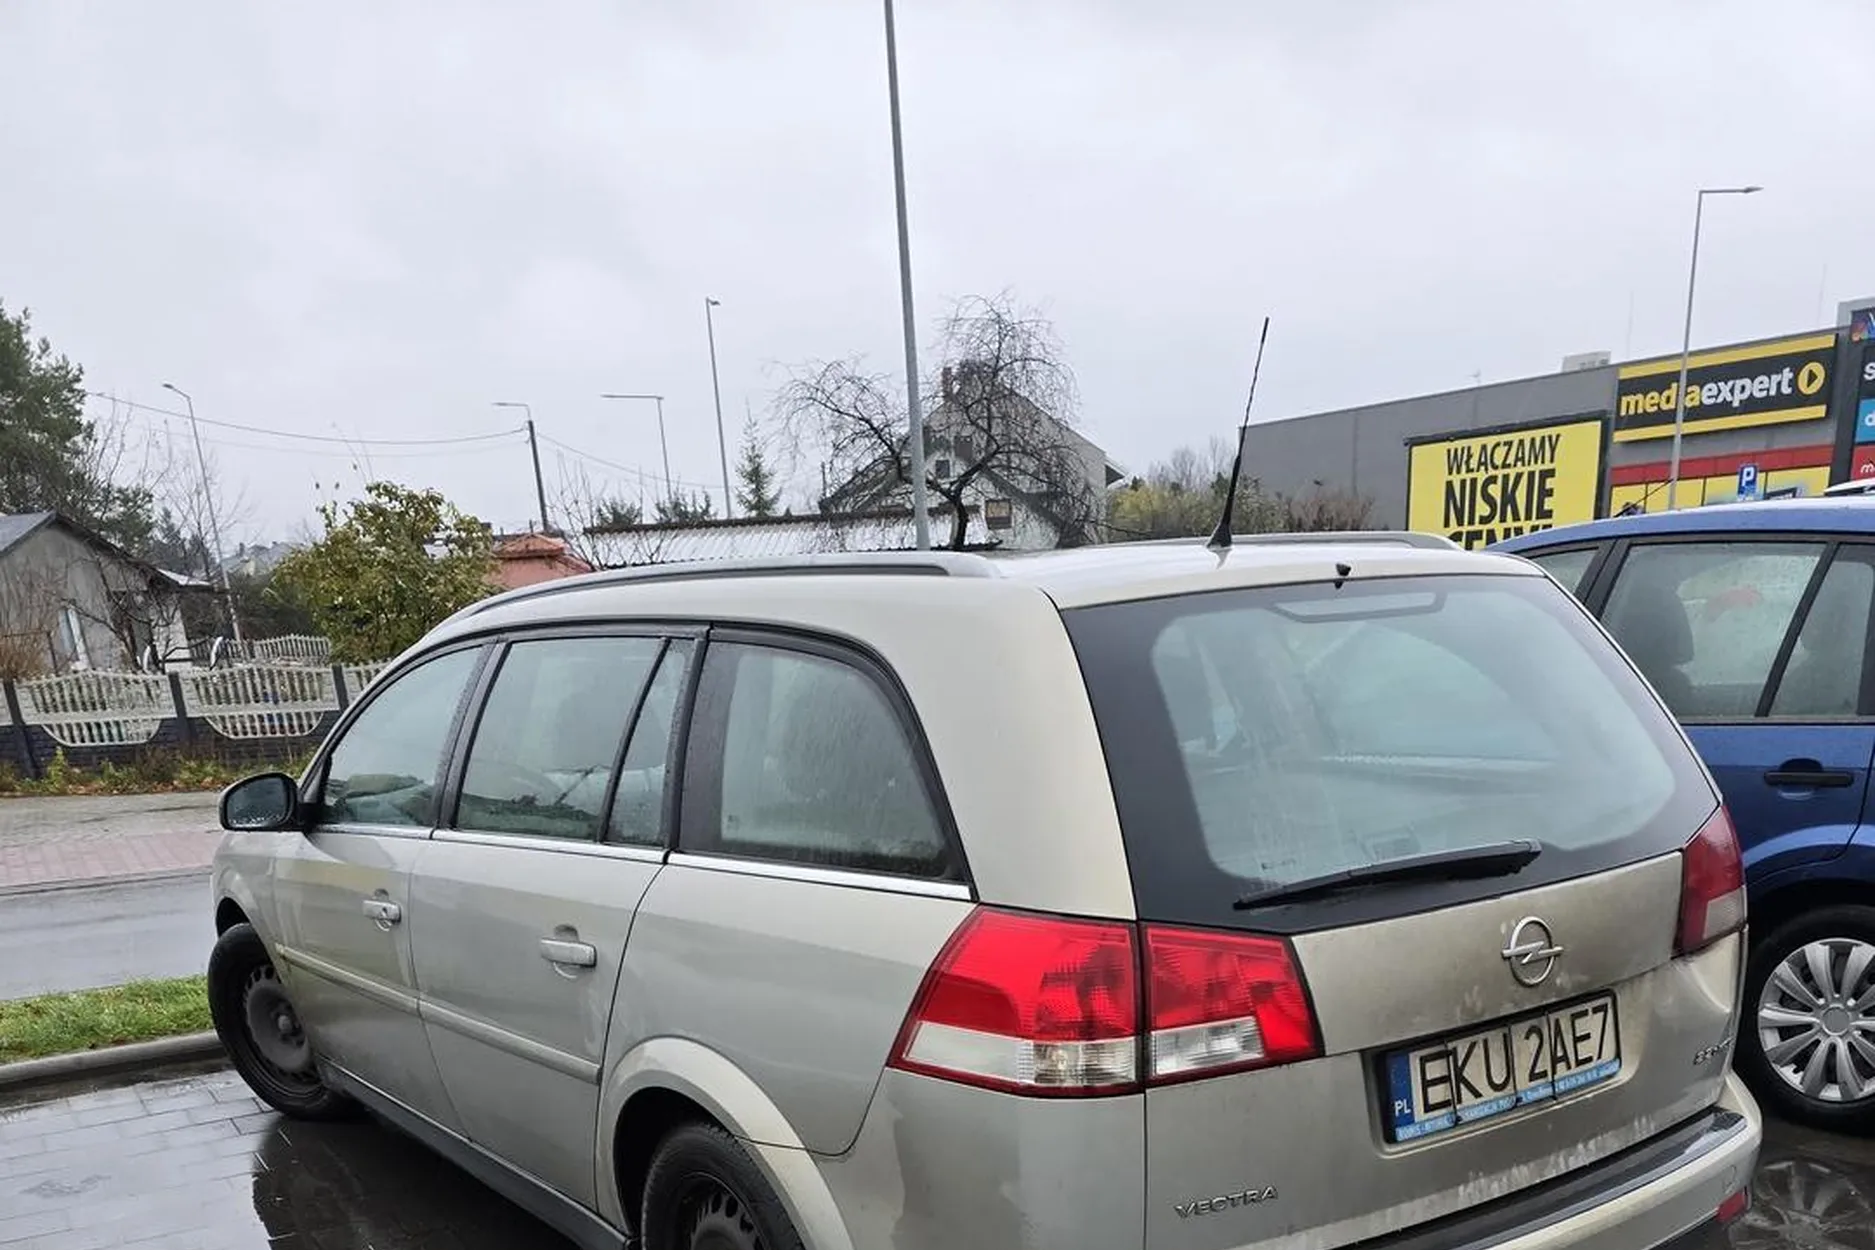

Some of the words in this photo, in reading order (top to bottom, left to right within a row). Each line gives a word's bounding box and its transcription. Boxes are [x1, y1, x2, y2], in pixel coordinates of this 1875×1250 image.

[1619, 367, 1794, 417] medaexpert
[1446, 434, 1560, 475] WŁĄCZAMY
[1741, 466, 1755, 487] P
[1443, 468, 1556, 528] NISKIE
[1419, 1032, 1512, 1113] EKU
[1524, 1003, 1609, 1083] 2AE7
[1394, 1098, 1412, 1116] PL
[1174, 1186, 1278, 1218] VECTRA
